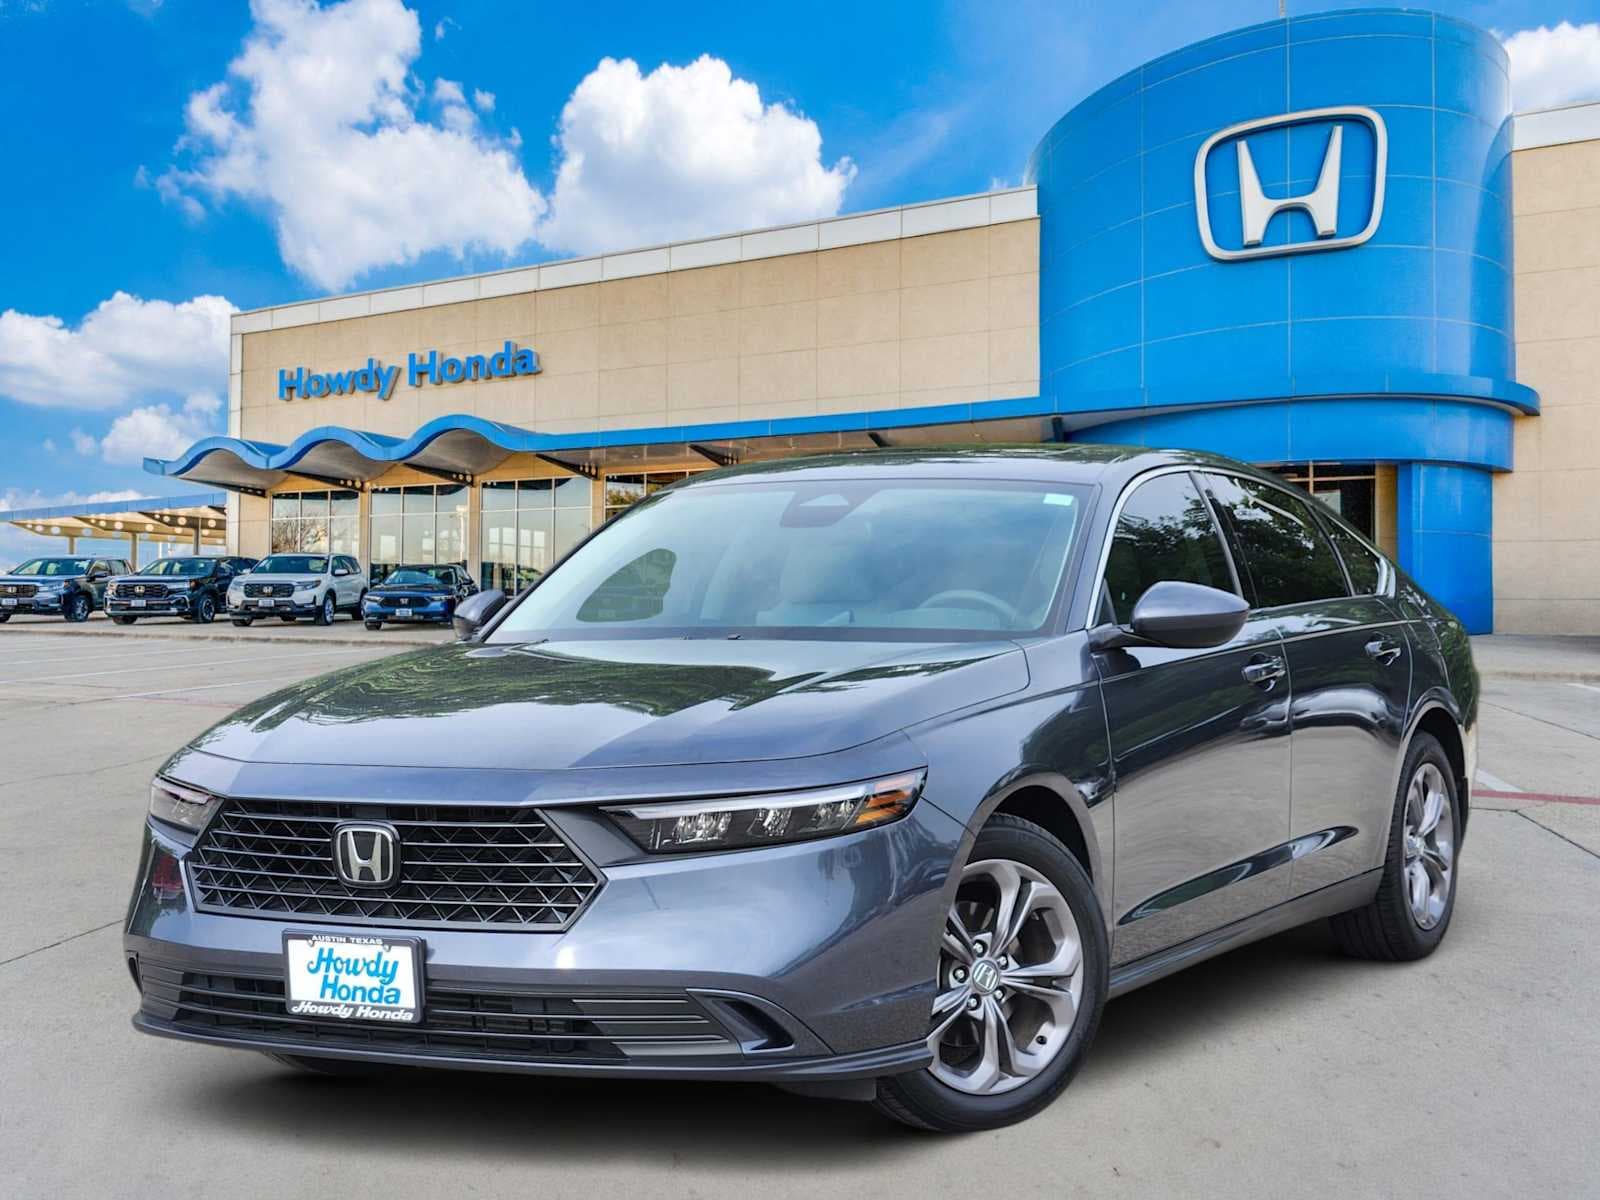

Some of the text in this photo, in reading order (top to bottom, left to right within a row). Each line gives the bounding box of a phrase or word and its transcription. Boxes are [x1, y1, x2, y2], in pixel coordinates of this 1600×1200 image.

[278, 340, 542, 401] Howdy Honda
[311, 935, 384, 945] AUSTIN TEXAS
[307, 947, 399, 985] Howdy
[320, 975, 401, 1004] Honda
[291, 1001, 414, 1021] Howdy Honda
